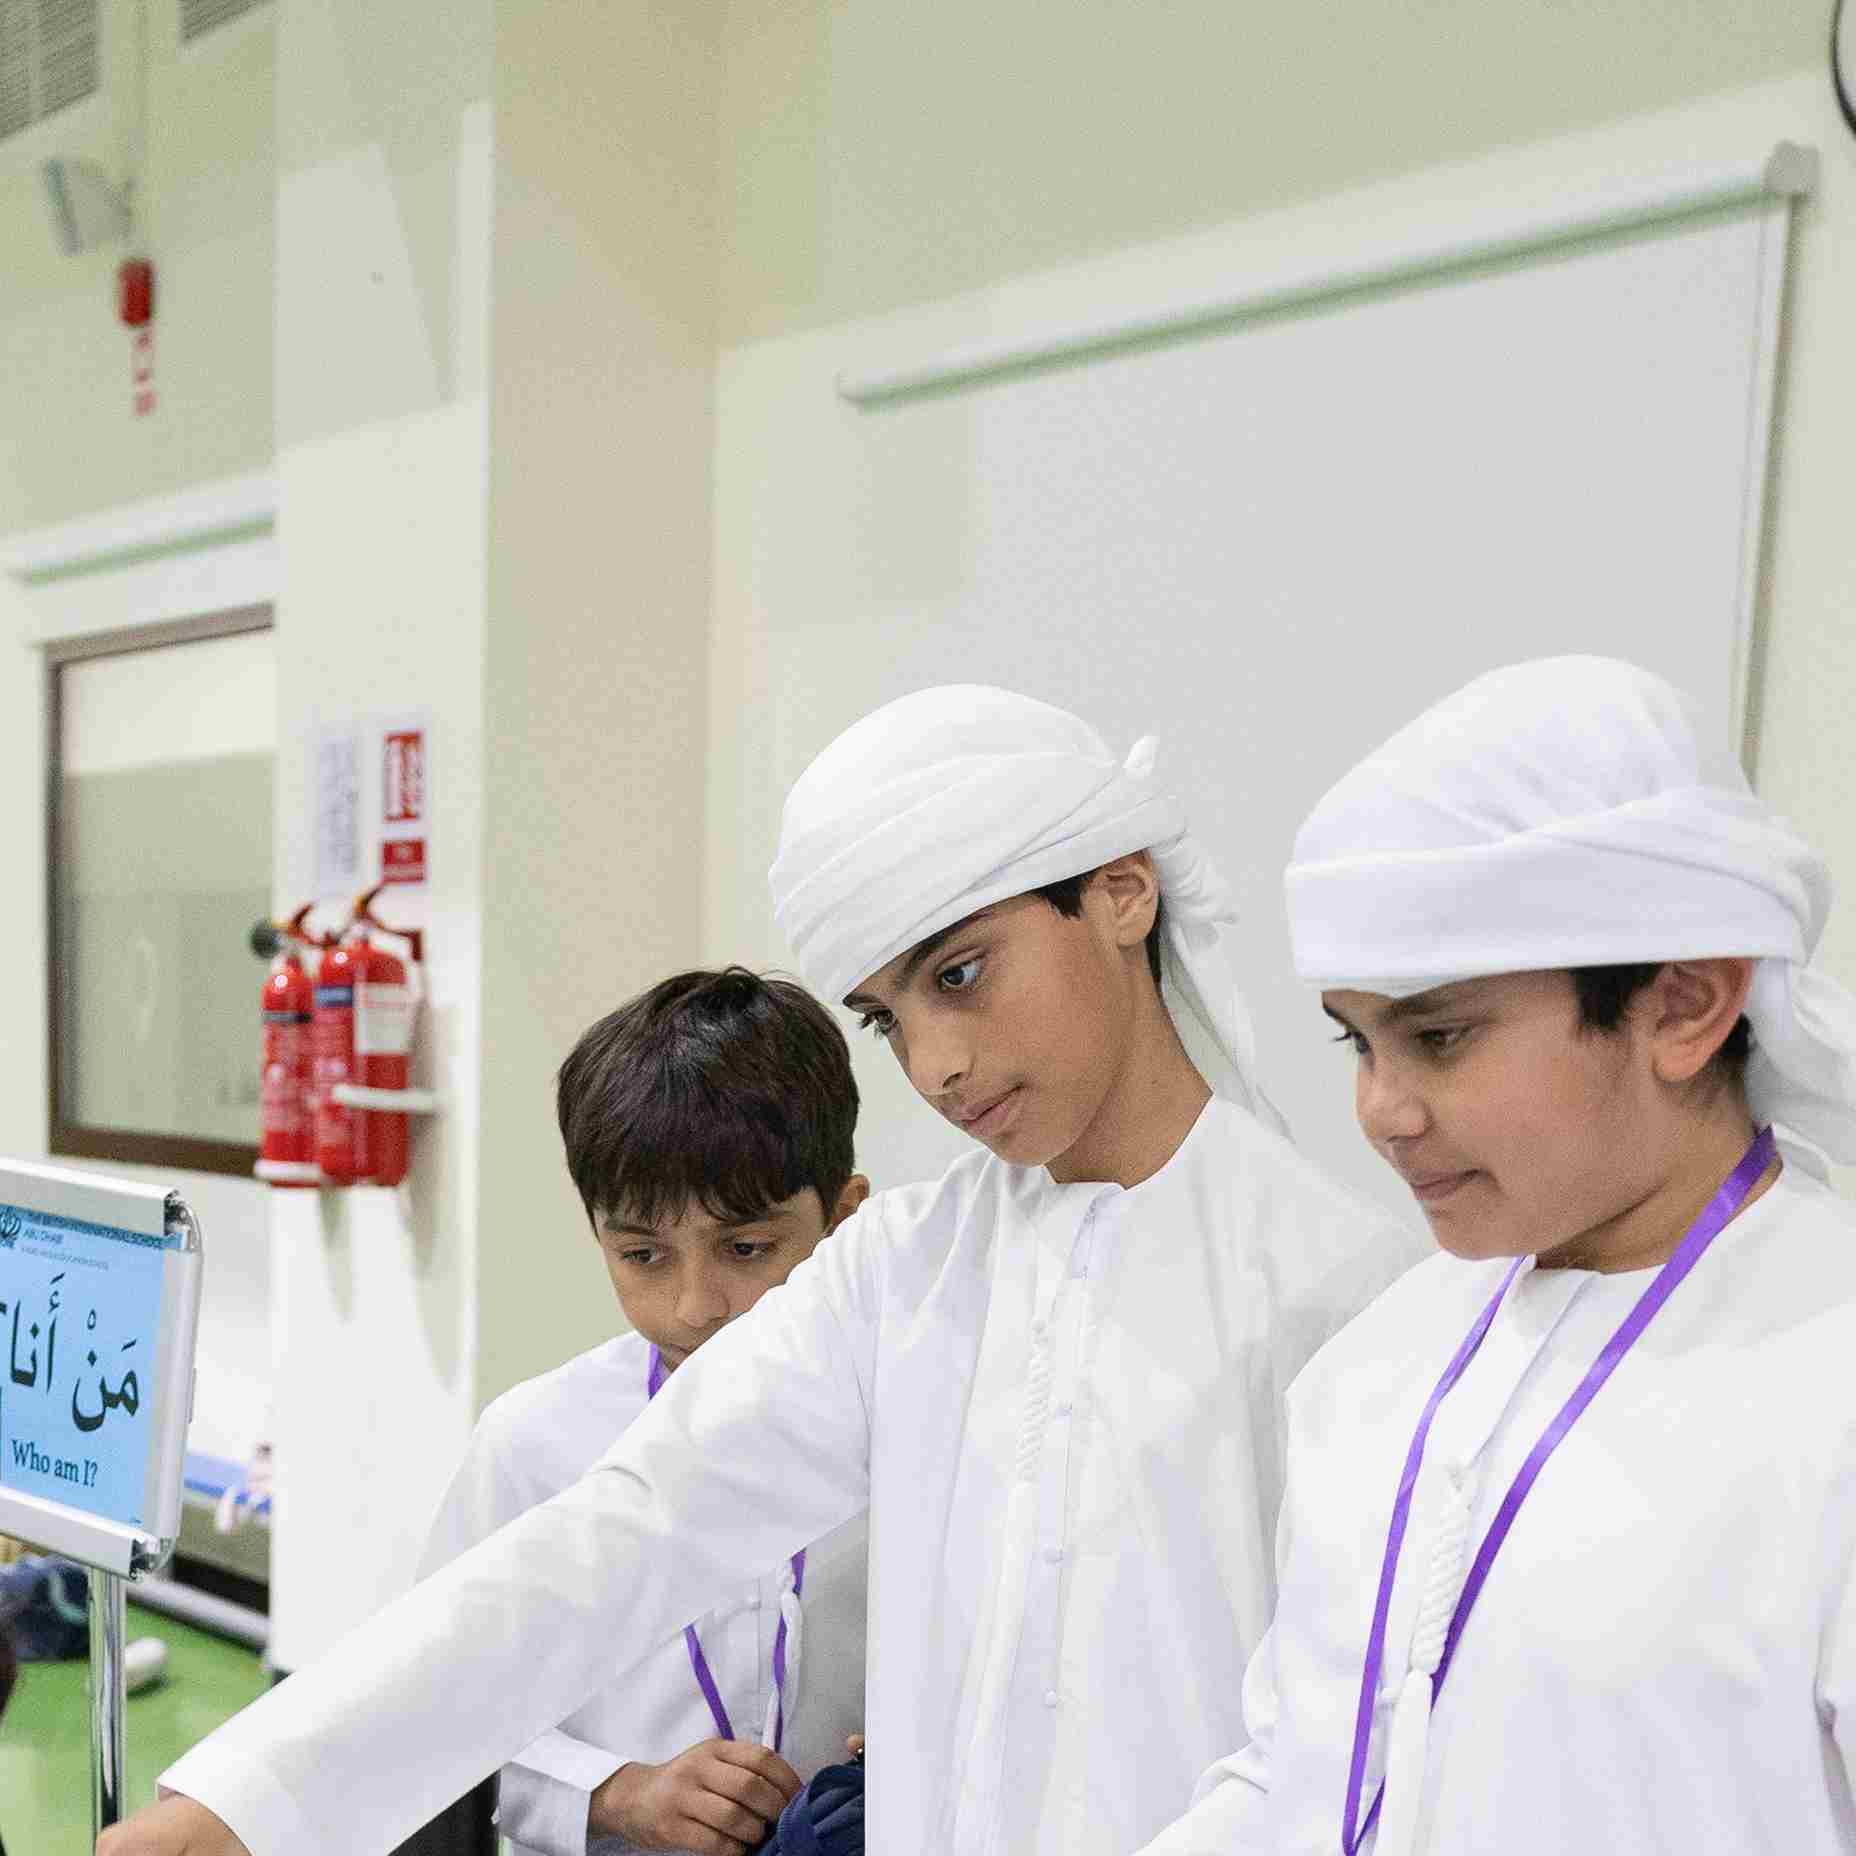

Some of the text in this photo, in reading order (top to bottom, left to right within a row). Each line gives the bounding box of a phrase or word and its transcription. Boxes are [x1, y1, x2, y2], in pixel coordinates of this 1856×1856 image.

[11, 1439, 98, 1488] Who am I?
